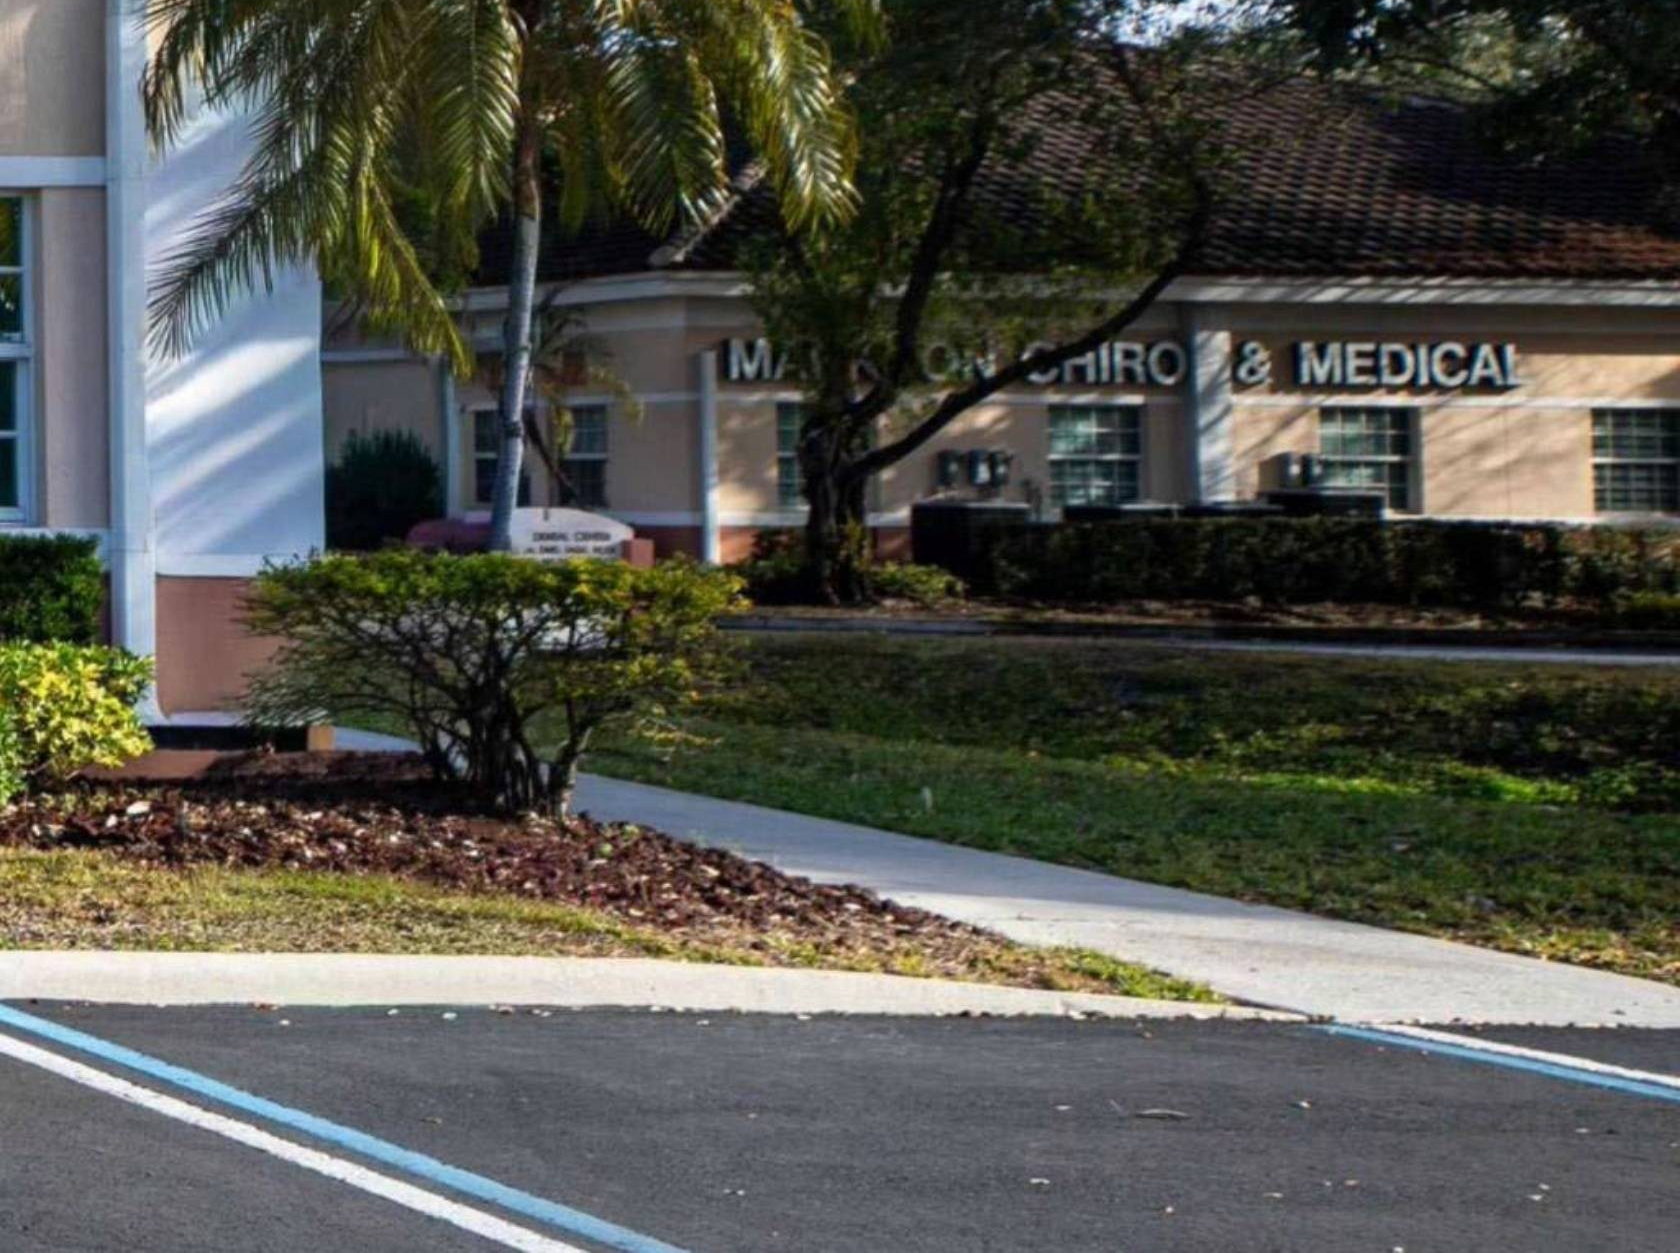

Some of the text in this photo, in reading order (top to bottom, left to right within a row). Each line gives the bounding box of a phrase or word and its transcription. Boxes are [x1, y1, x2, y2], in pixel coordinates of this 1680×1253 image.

[1023, 341, 1187, 385] CHIRO
[1236, 340, 1273, 383] &
[1297, 341, 1523, 387] MEDICAL
